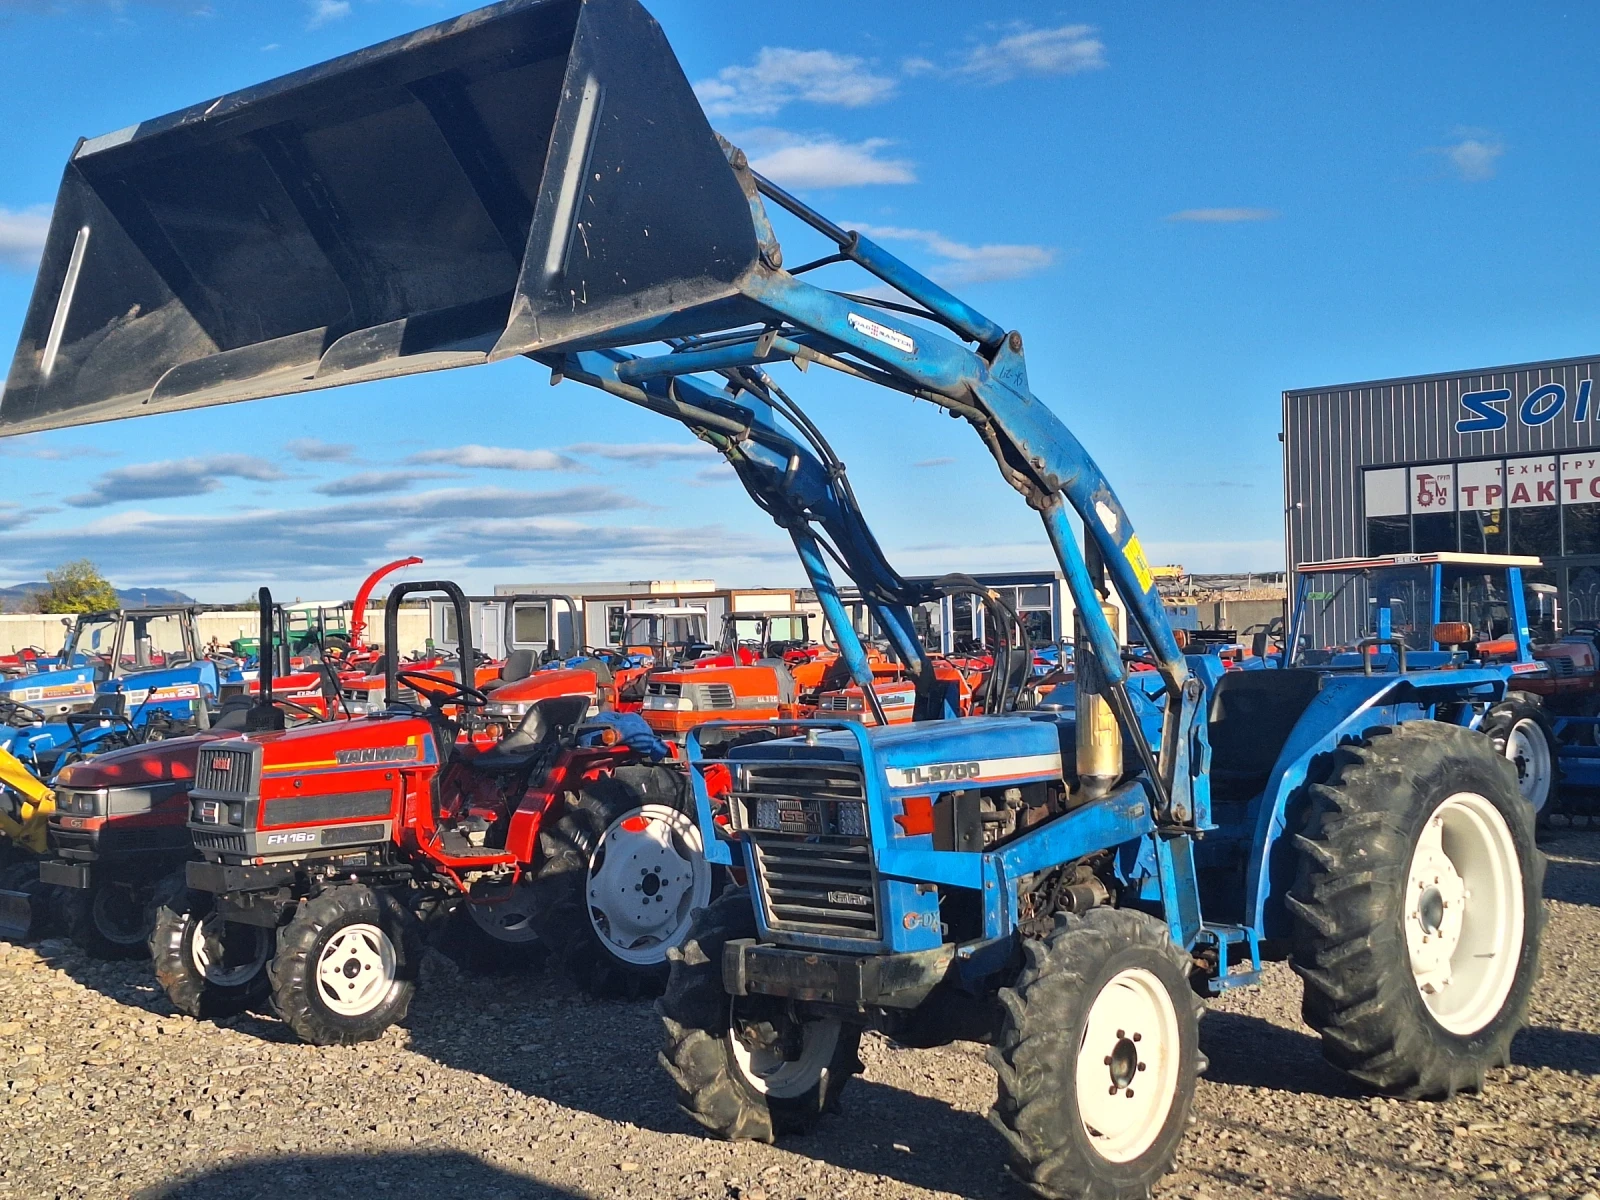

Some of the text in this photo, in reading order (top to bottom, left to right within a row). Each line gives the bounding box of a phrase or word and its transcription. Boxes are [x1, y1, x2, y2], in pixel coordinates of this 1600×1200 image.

[1455, 379, 1600, 433] SOI
[335, 745, 418, 764] YANMAR
[902, 763, 980, 784] TL3700
[781, 810, 818, 823] ISEKI
